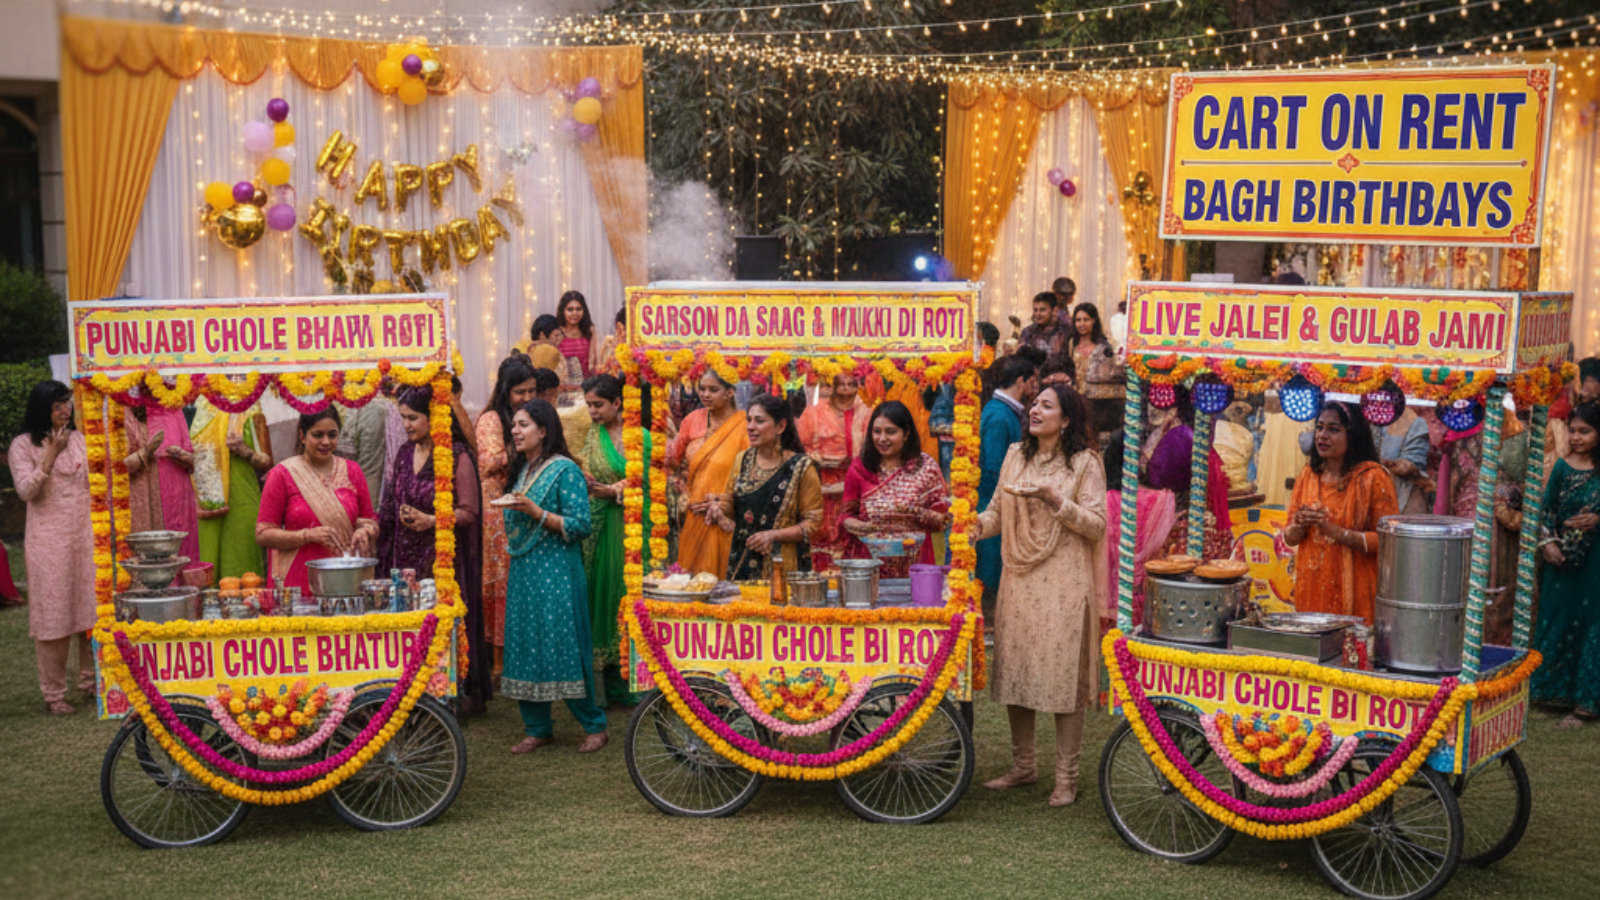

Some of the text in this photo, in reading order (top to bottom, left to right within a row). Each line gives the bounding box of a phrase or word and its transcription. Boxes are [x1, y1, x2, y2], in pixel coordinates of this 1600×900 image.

[1193, 92, 1527, 151] CART ON RENT
[1183, 179, 1513, 229] BAGH BIRTHBAYS
[86, 319, 195, 357] PUNJABI
[204, 316, 287, 353] CHOLE
[641, 305, 719, 337] SARSON
[725, 306, 750, 336] DA
[756, 306, 805, 337] SAAG
[898, 307, 916, 337] DI
[1139, 301, 1201, 336] LIVE
[1209, 304, 1290, 340] JALEI
[1299, 306, 1319, 341] &
[1329, 307, 1420, 346] GULAB
[1429, 311, 1506, 351] JAMI
[223, 636, 307, 677] CHOLE
[657, 621, 763, 661] PUNJABI
[773, 625, 853, 662] CHOLE
[864, 627, 888, 663] BI
[1235, 672, 1322, 716] CHOLE
[1331, 689, 1357, 722] BI
